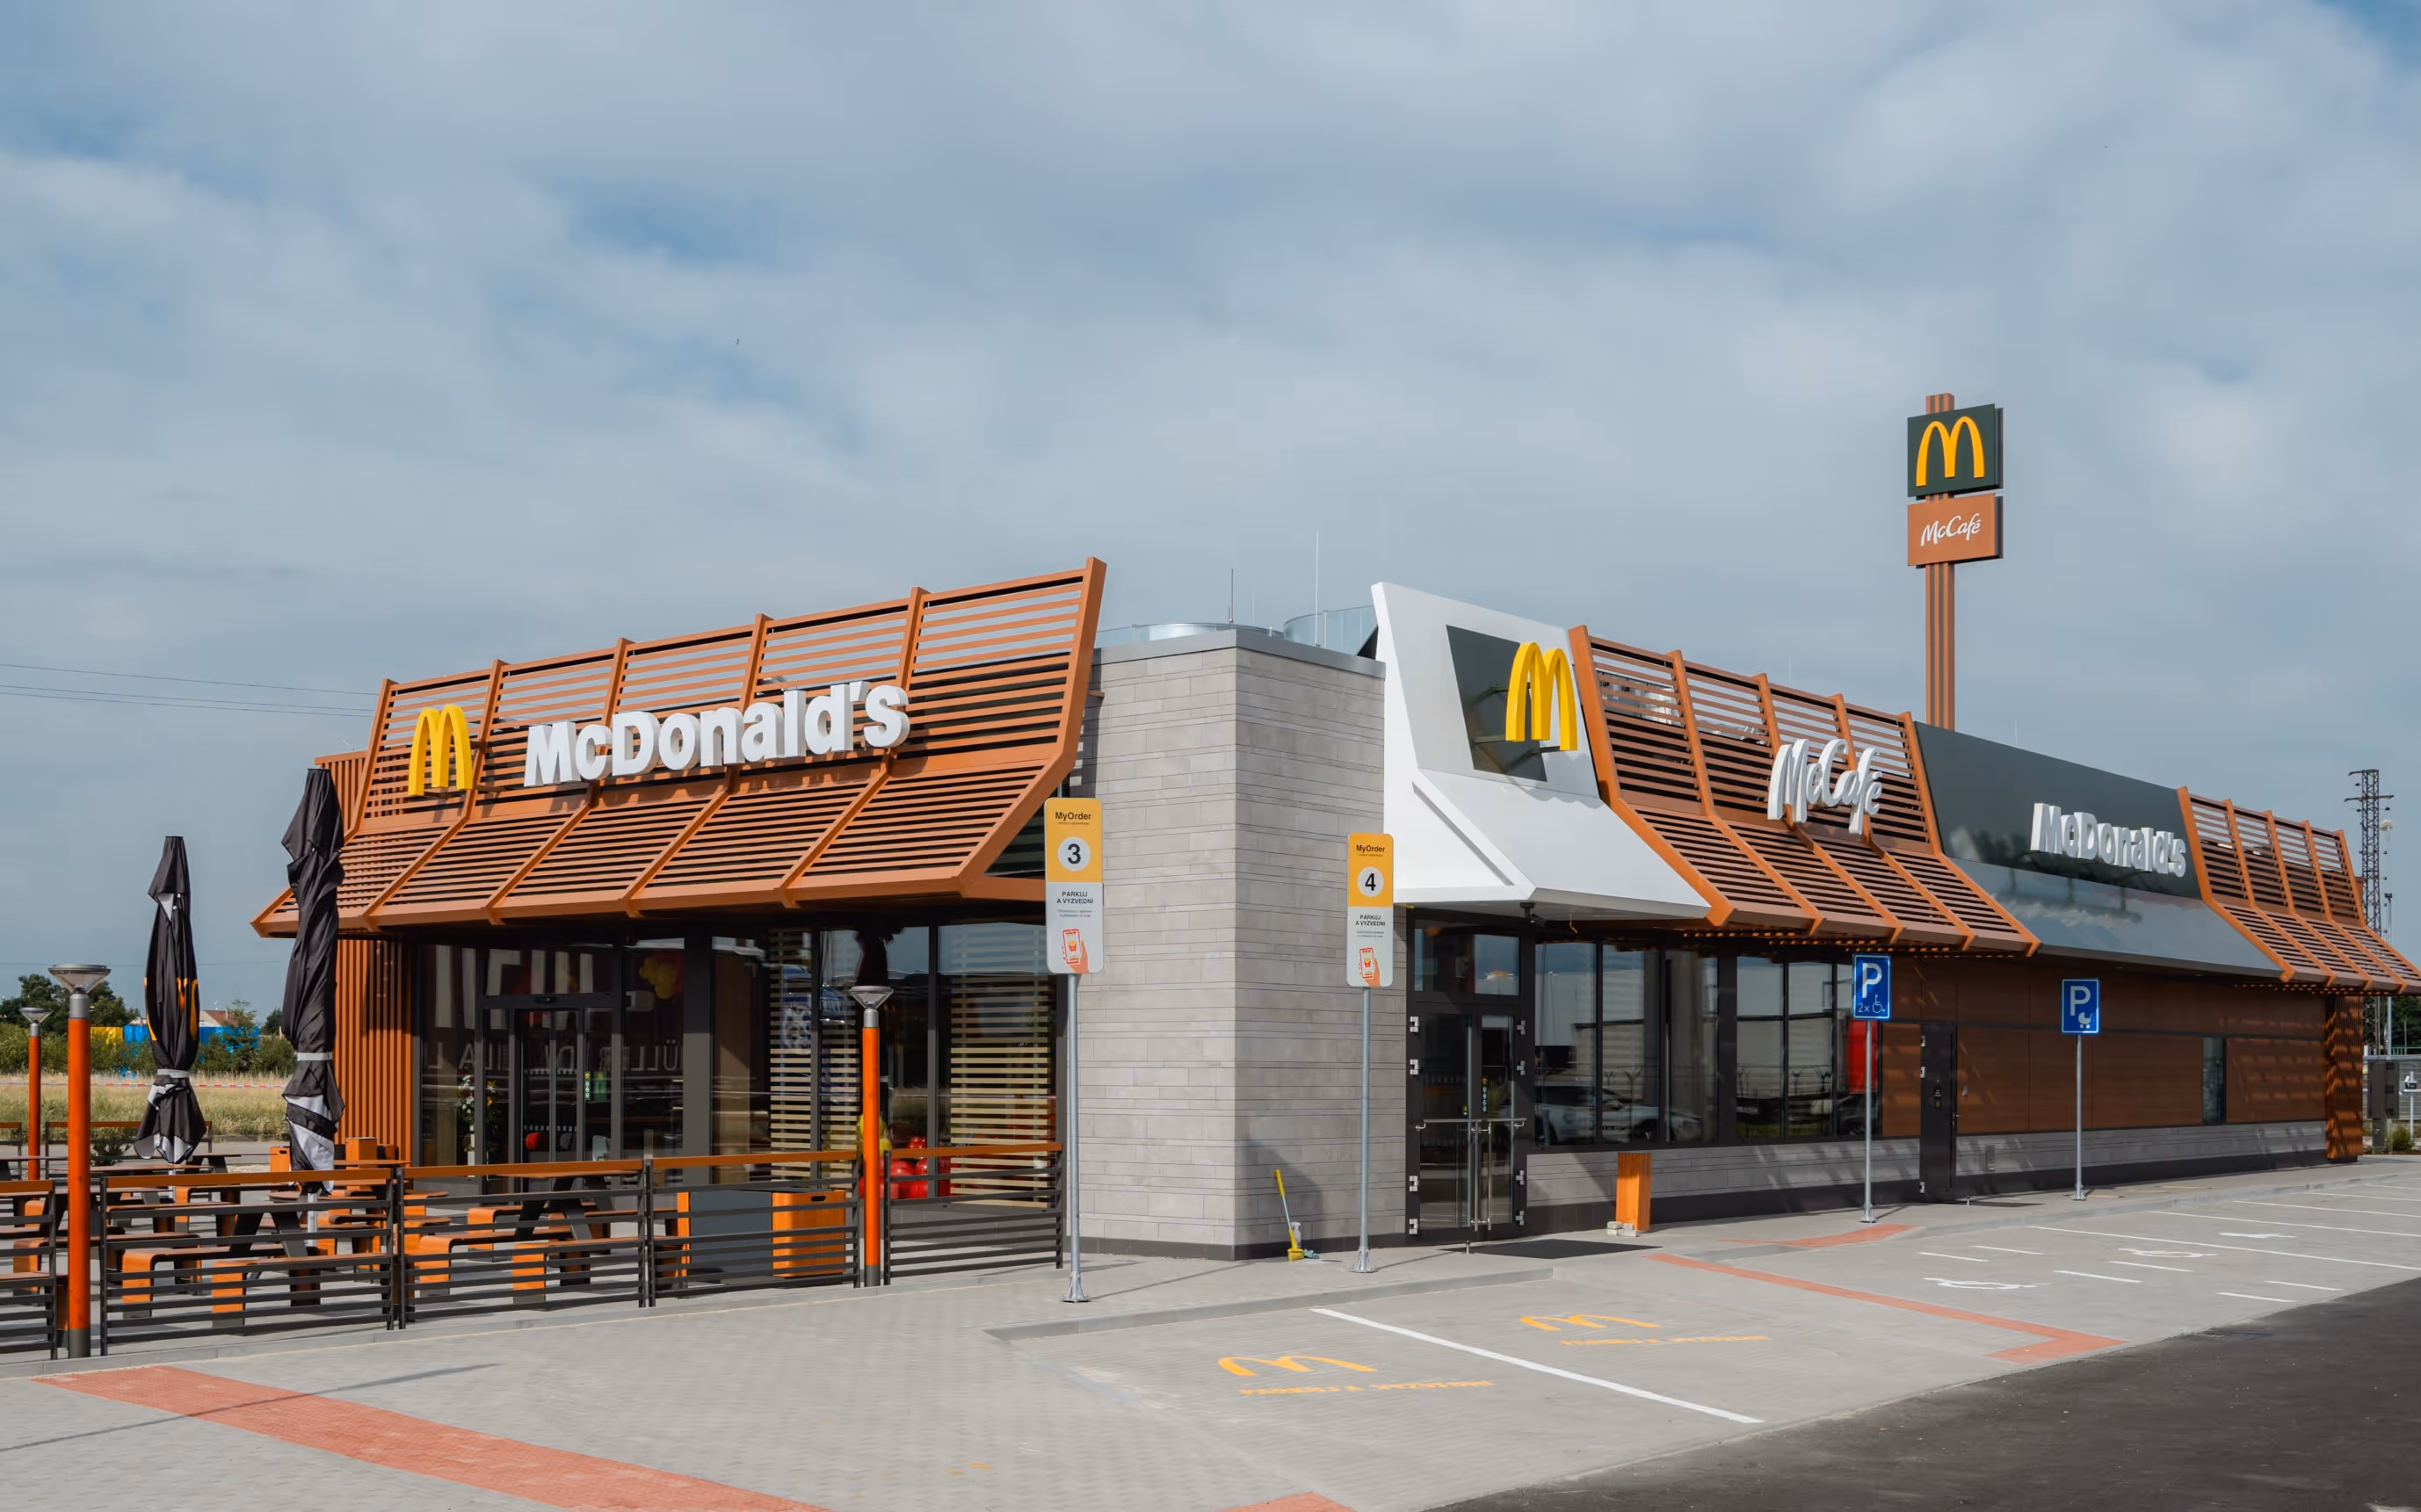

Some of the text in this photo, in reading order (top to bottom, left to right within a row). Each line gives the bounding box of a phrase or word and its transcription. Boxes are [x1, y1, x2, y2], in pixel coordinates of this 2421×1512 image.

[1920, 513, 1981, 546] McCafé
[524, 681, 910, 788] McDonald's
[1767, 739, 1882, 835] McCafé
[1055, 812, 1092, 821] MyOrder
[1067, 843, 1082, 865] 3
[1356, 845, 1386, 854] MyOrder
[2030, 803, 2186, 878] McDonald's
[1365, 872, 1376, 891] 4
[1862, 963, 1882, 998] P
[2070, 986, 2091, 1016] P
